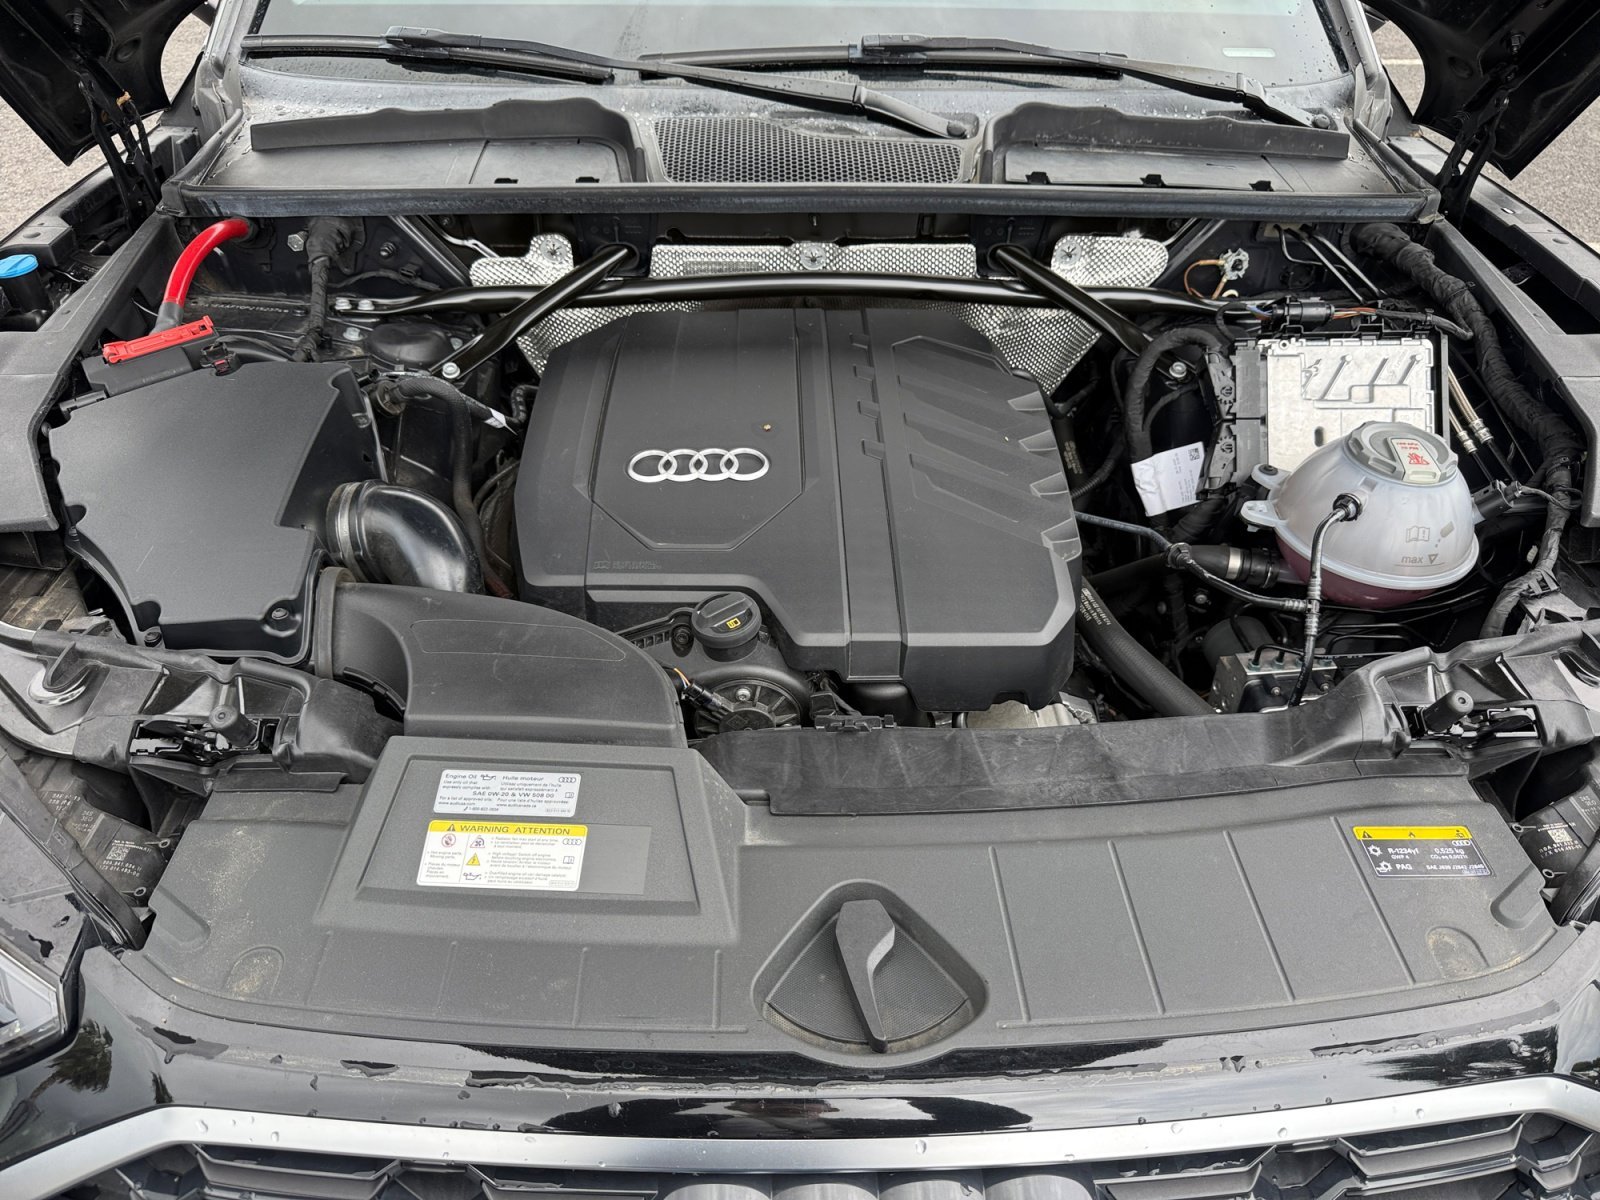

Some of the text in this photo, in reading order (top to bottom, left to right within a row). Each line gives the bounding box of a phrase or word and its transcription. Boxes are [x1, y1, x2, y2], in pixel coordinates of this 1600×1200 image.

[1401, 555, 1423, 564] max
[460, 825, 570, 835] WARNING ATTENTION
